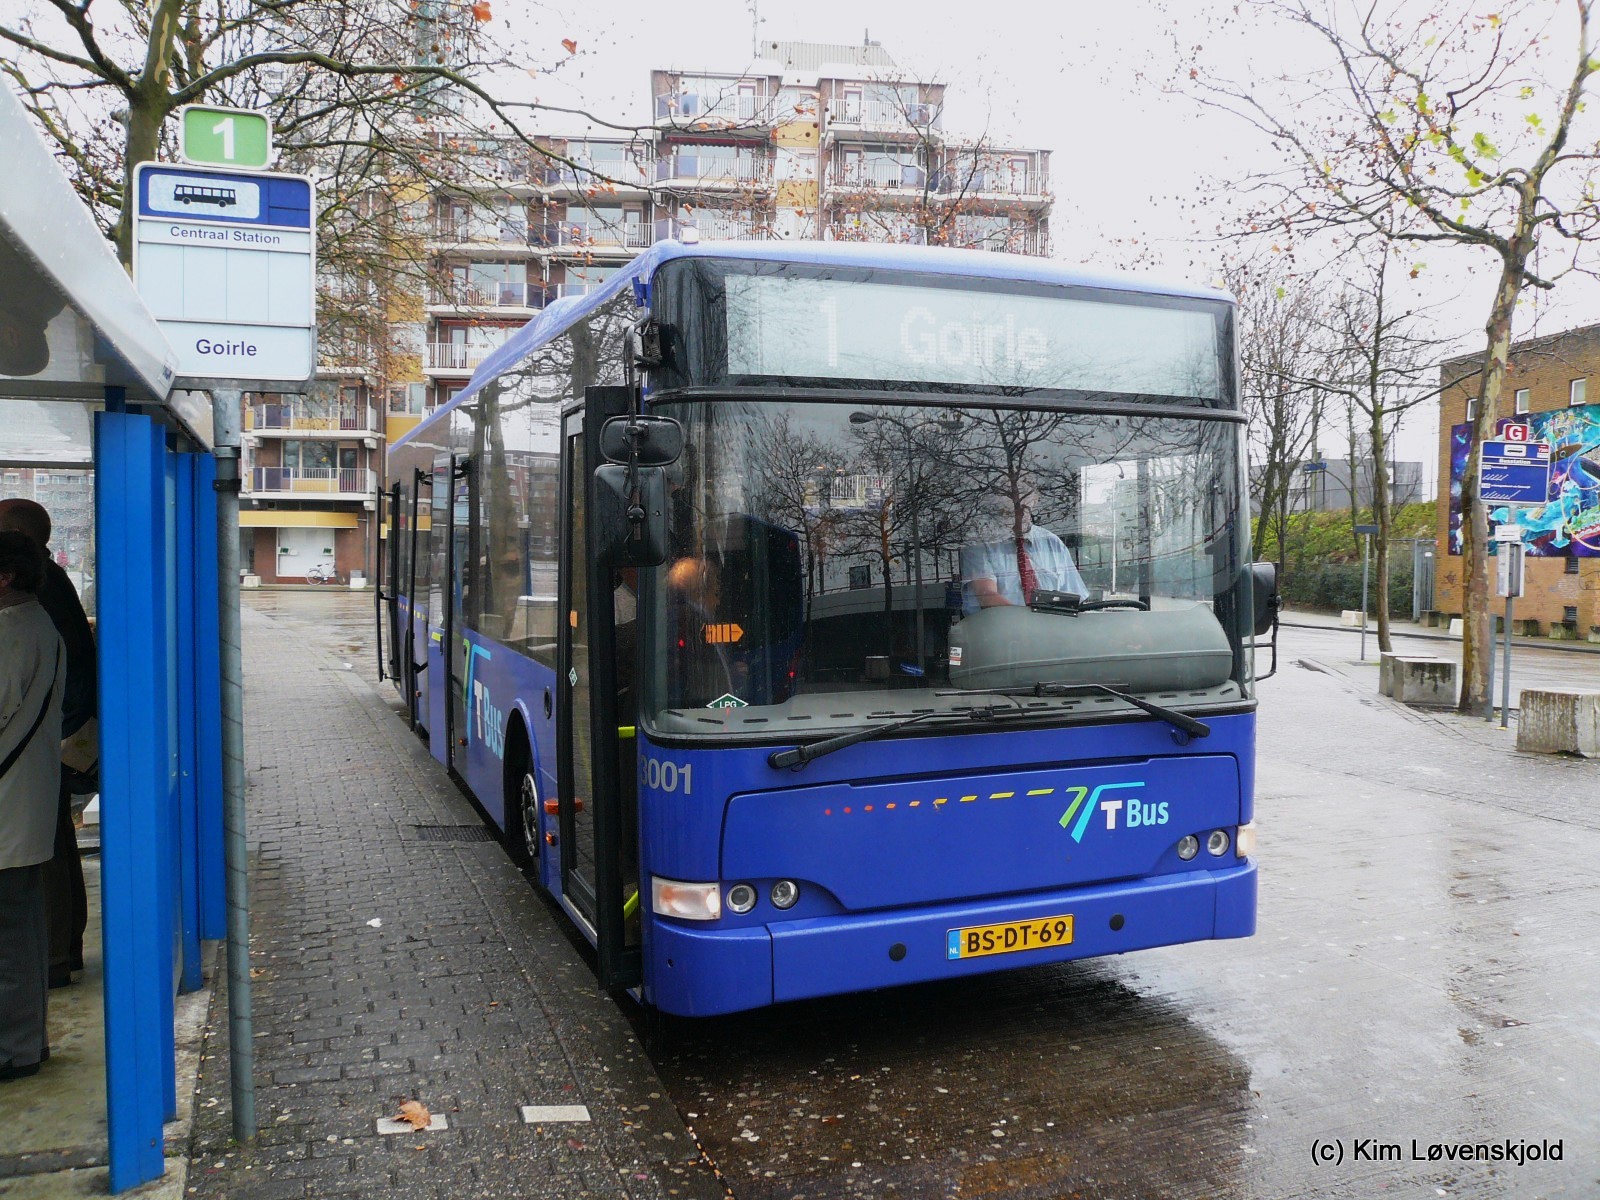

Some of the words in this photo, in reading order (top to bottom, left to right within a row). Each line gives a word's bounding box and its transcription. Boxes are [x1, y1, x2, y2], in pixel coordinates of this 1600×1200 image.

[213, 117, 235, 160] 1
[170, 226, 229, 241] Centraal
[233, 230, 281, 244] Station
[819, 296, 838, 367] 1
[900, 306, 1048, 370] Goirle
[195, 339, 258, 357] Goirle
[1508, 425, 1523, 441] G
[719, 700, 737, 708] LPG
[1126, 798, 1169, 828] Bus
[967, 920, 1067, 953] BS-DT-69
